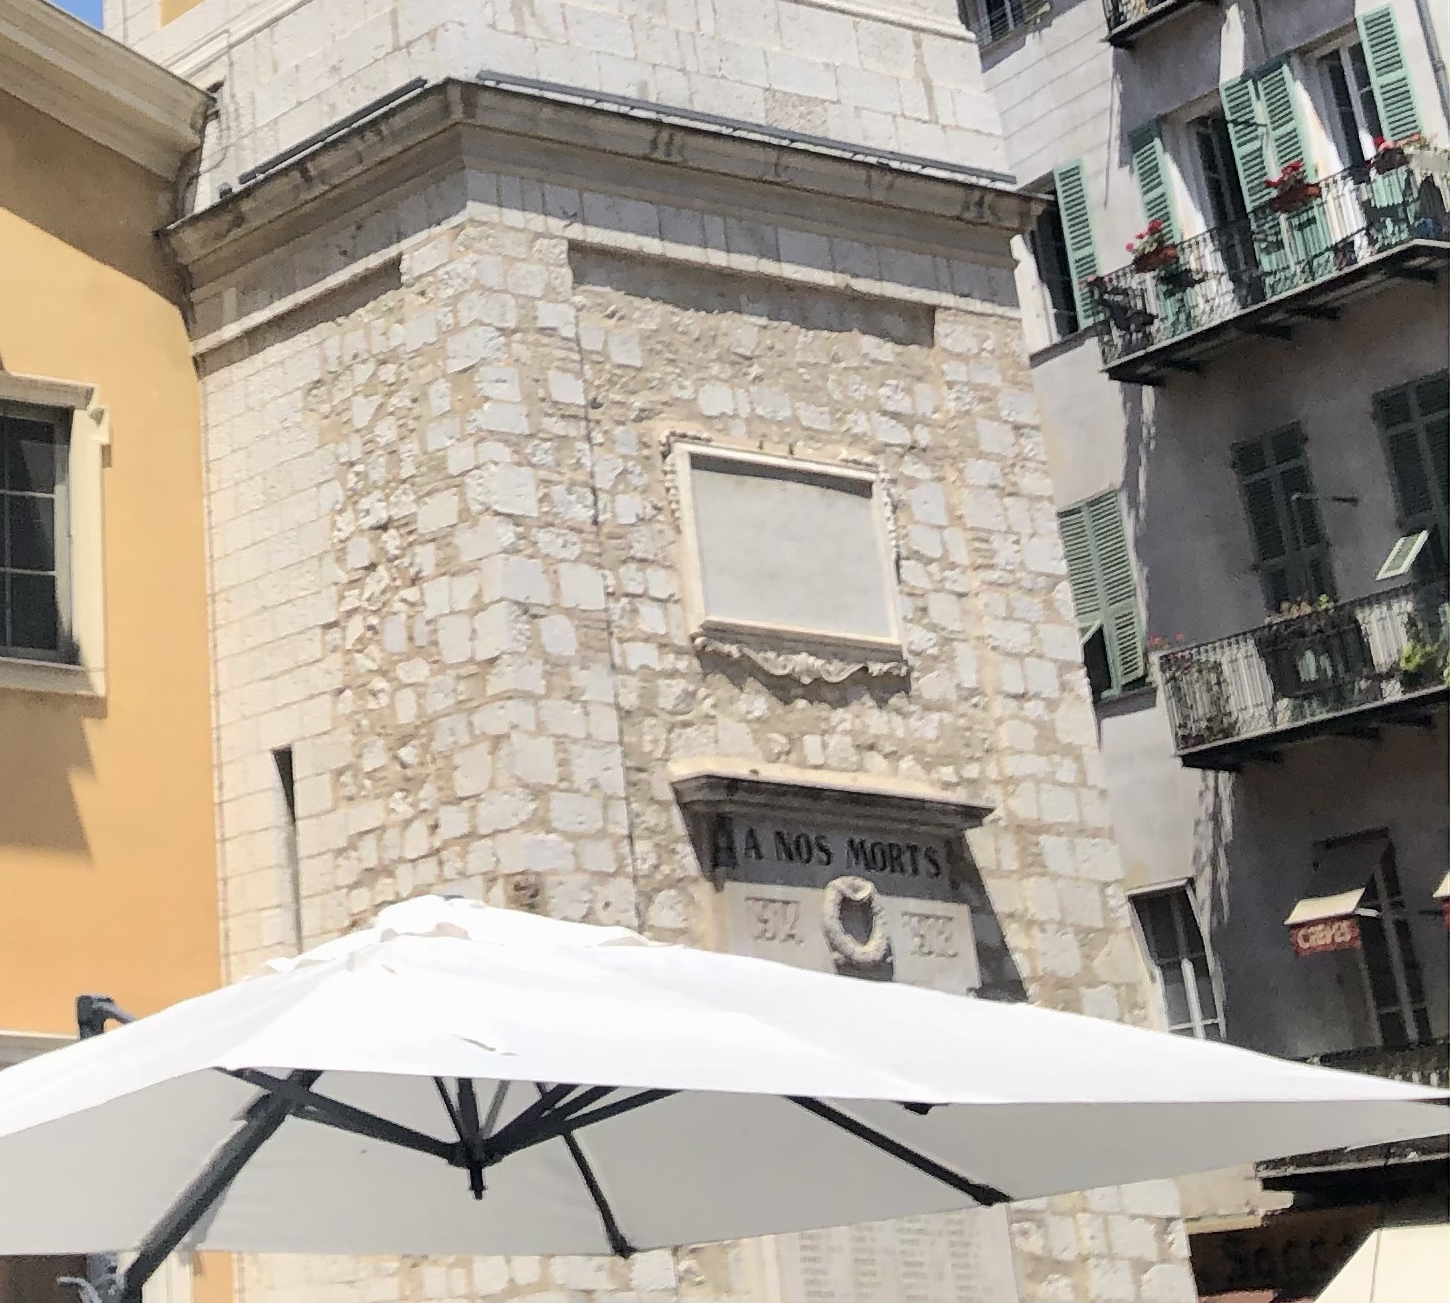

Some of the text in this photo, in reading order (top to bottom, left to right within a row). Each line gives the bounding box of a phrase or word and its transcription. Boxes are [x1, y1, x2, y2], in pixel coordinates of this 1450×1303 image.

[744, 826, 942, 880] A NOS MORTS
